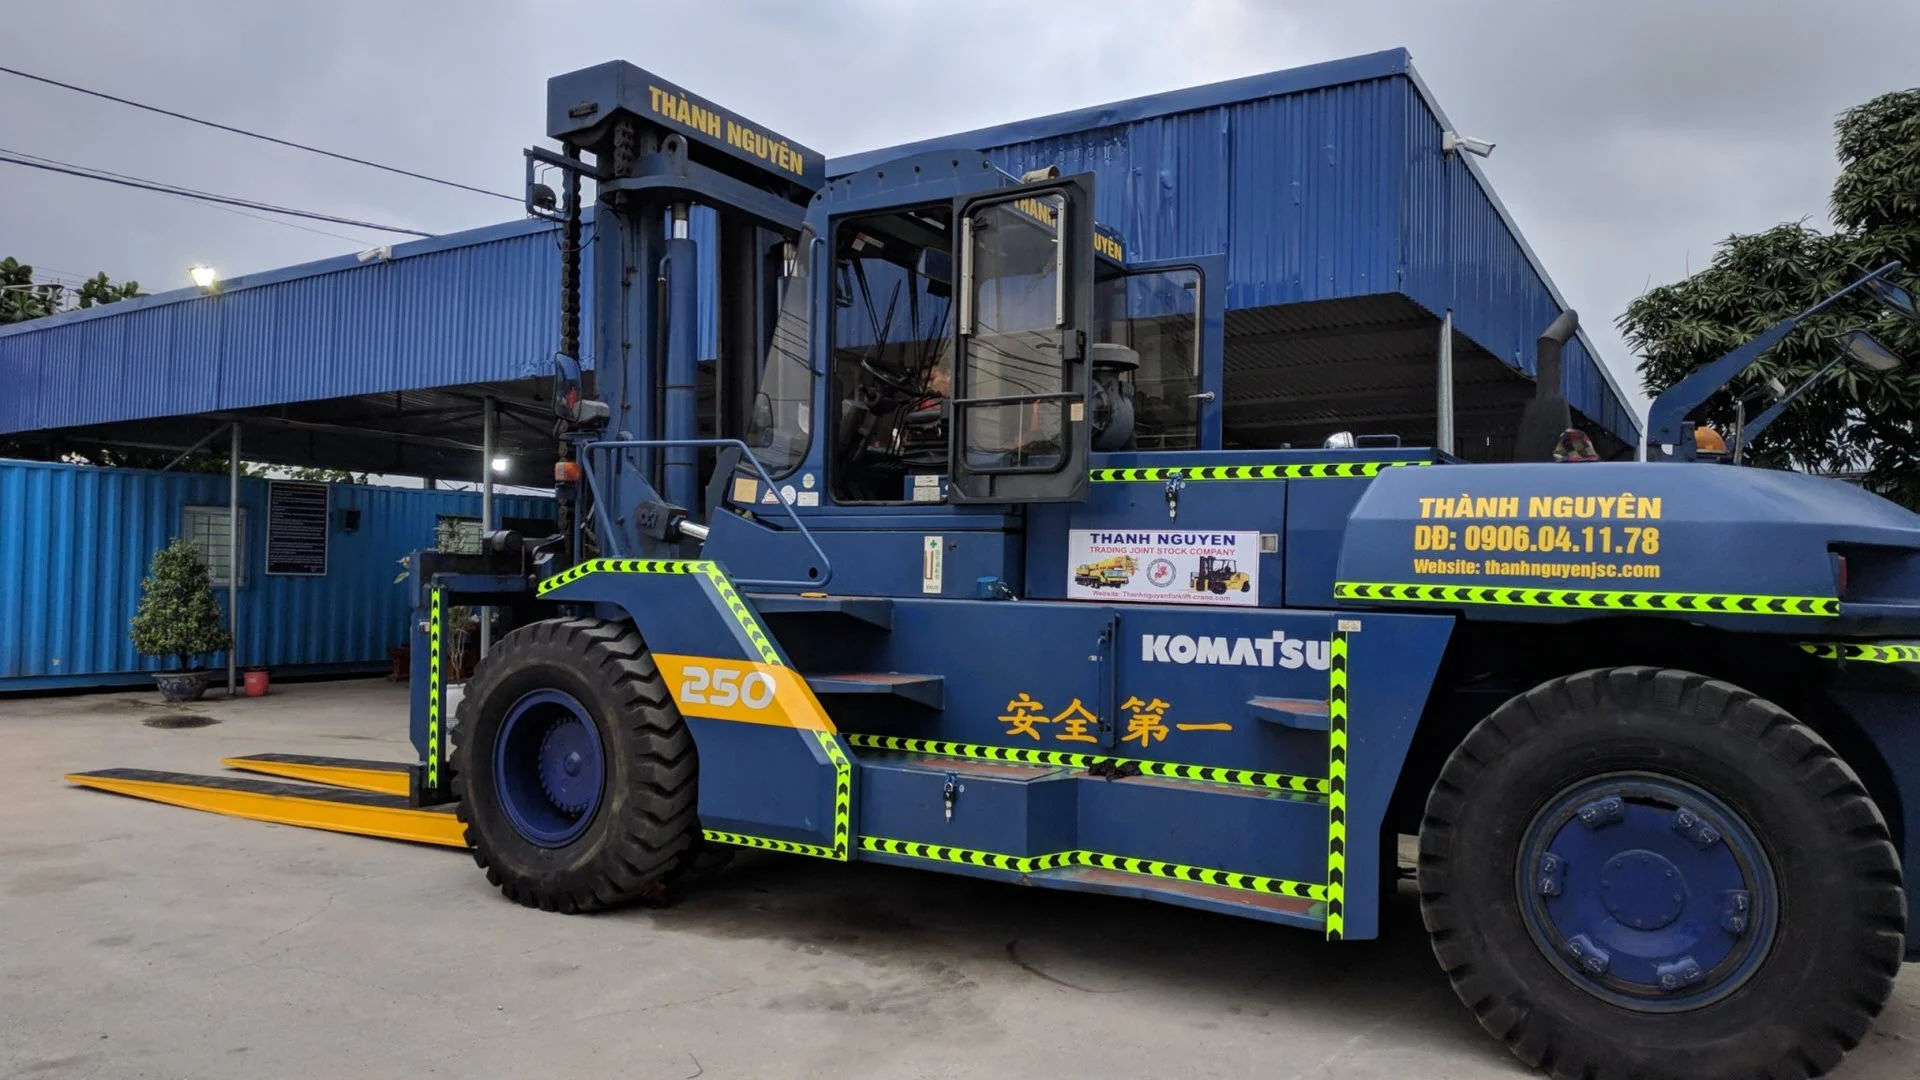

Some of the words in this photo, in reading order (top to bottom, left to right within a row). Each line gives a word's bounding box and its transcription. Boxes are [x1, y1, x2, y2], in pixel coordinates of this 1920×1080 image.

[649, 85, 721, 139] THÀNH
[727, 120, 803, 176] NGUYÊN
[1419, 493, 1519, 519] THÀNH
[1528, 492, 1662, 519] NGUYÊN
[1089, 546, 1127, 554] TRADING
[1156, 547, 1188, 555] STOCK
[1189, 548, 1236, 556] COMPANY
[1090, 533, 1150, 544] THANH
[1157, 534, 1236, 546] NGUYEN
[1414, 525, 1456, 551] DĐ:
[1464, 525, 1660, 555] 0906.04.11.78
[1413, 559, 1480, 575] Website:
[1485, 560, 1660, 580] thanhnguyenjsc.com
[1092, 590, 1119, 598] Website:
[1141, 631, 1330, 670] KOMATSU
[681, 666, 776, 710] 250
[997, 692, 1233, 748] 安全第一
